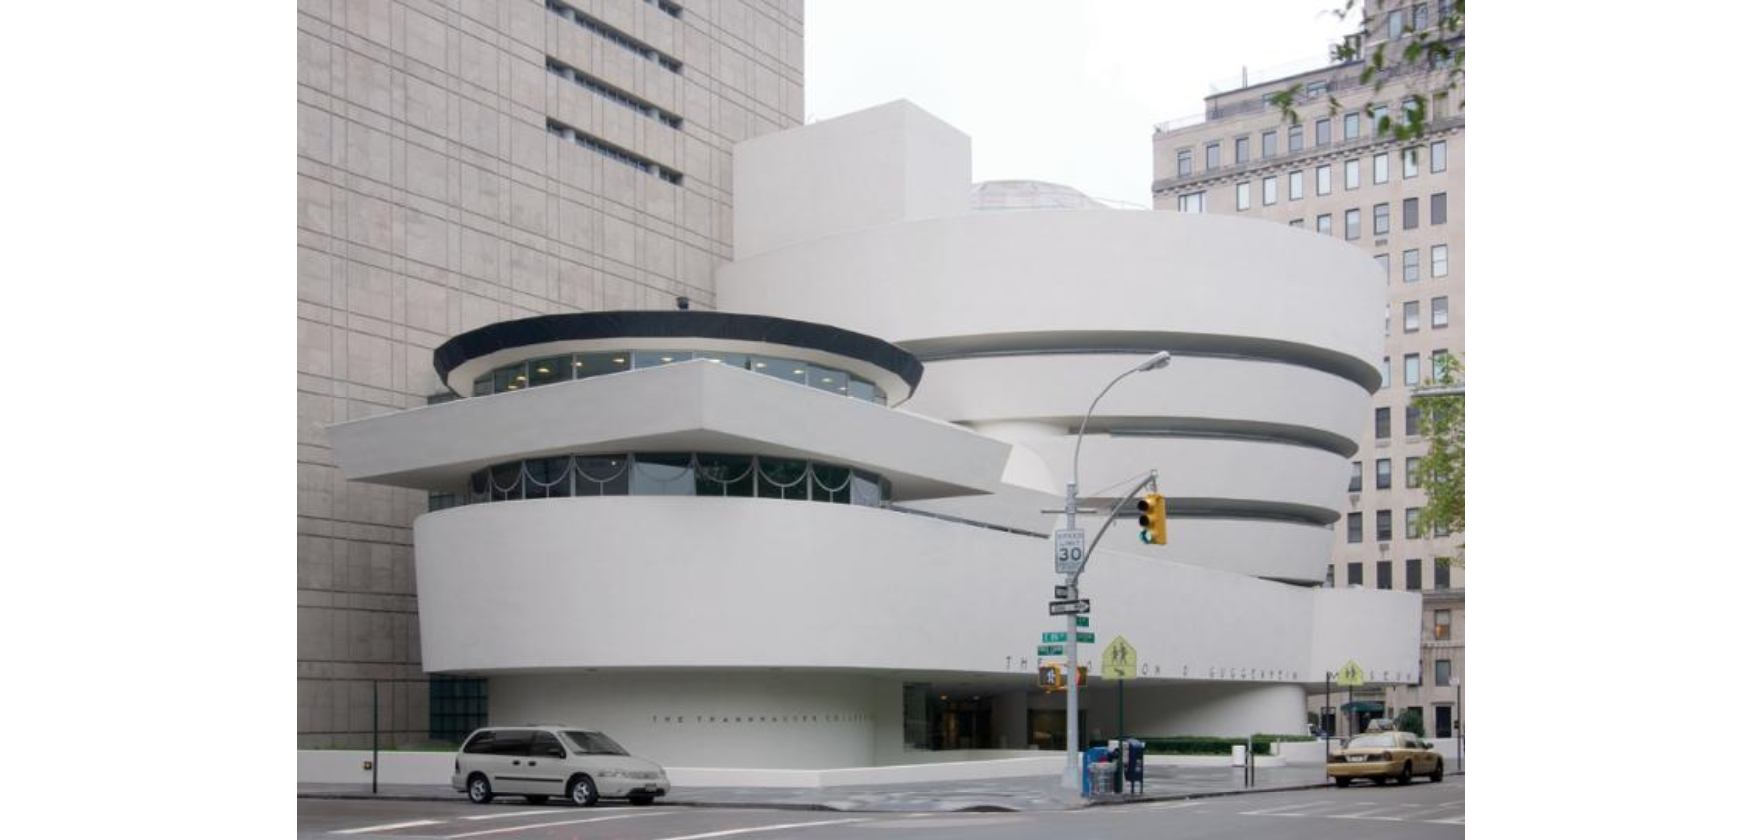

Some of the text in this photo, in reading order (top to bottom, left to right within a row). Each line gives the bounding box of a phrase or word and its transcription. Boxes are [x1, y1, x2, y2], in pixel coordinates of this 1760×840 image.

[1058, 547, 1082, 561] 30
[1328, 669, 1412, 681] MSEUM
[651, 714, 684, 724] THE
